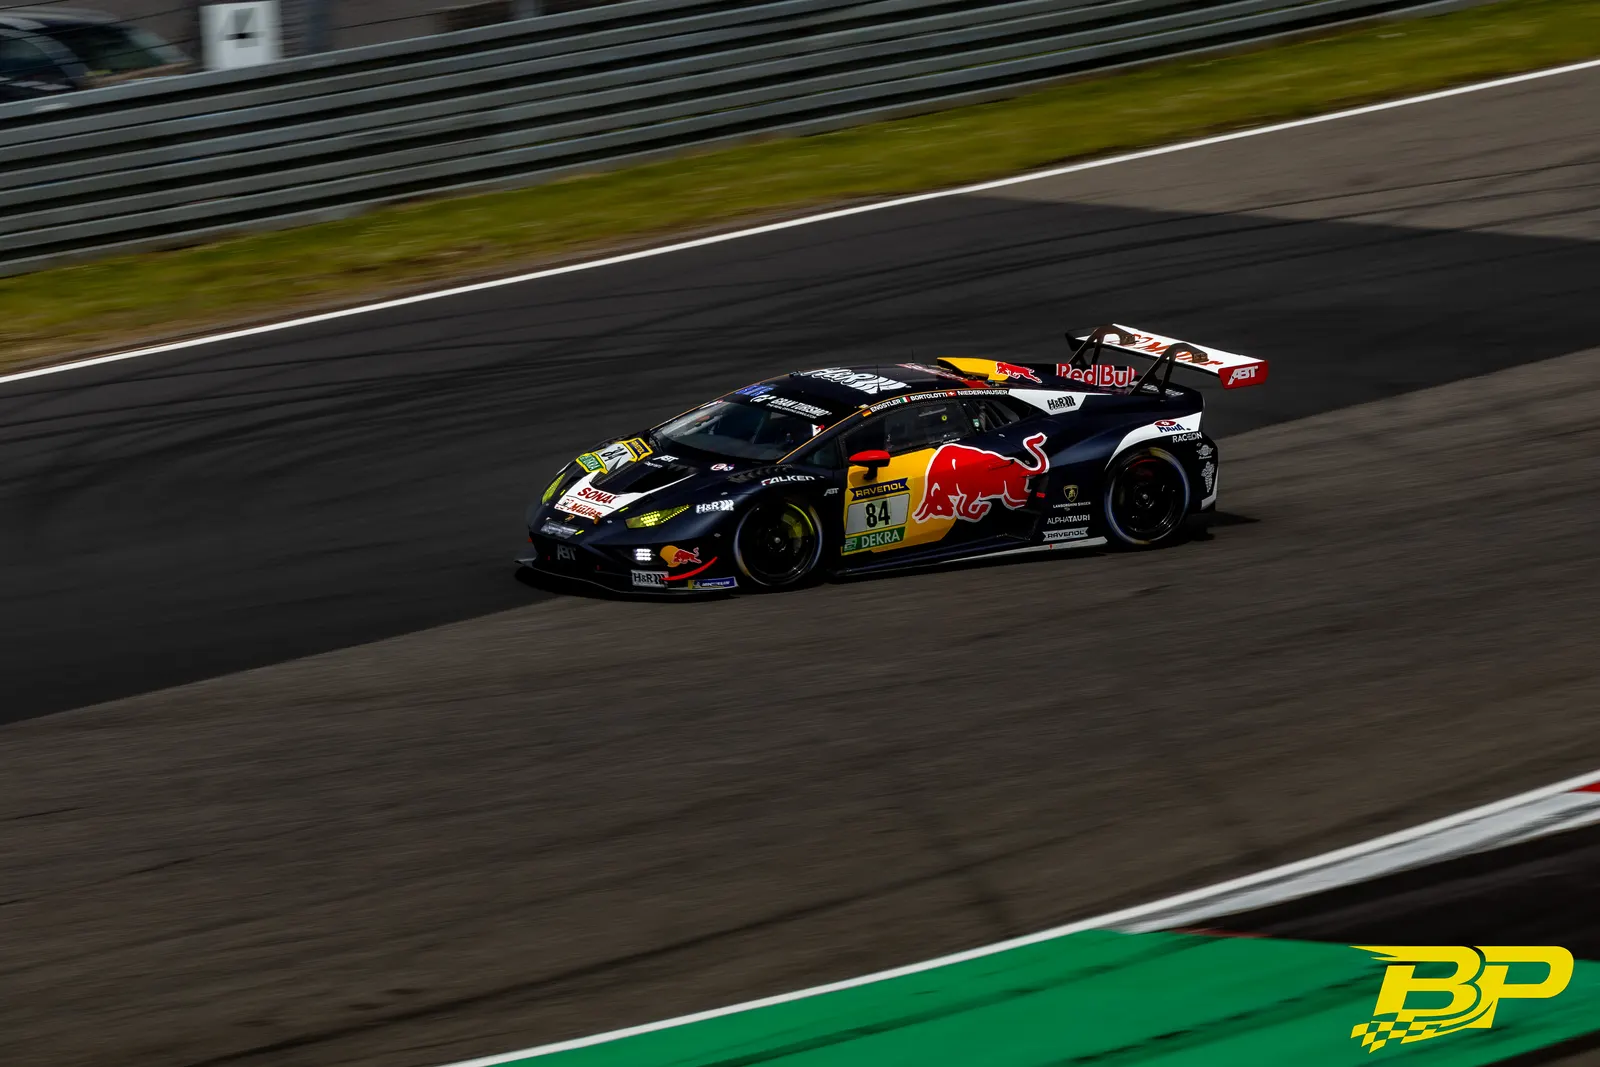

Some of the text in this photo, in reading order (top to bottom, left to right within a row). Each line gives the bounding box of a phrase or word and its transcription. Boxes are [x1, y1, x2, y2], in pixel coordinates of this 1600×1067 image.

[1056, 363, 1098, 386] Red
[1228, 366, 1259, 385] ABT
[870, 398, 901, 412] ENGSTLER
[910, 392, 948, 402] BORTOLOTTI
[1157, 424, 1185, 433] MAHA
[761, 475, 815, 486] FALKEN
[824, 488, 839, 496] ABT
[855, 483, 904, 498] RAVENOL
[865, 501, 890, 528] 84
[1047, 514, 1090, 524] ALPHATAURI
[861, 530, 900, 548] DEKRA
[557, 544, 576, 560] ABT
